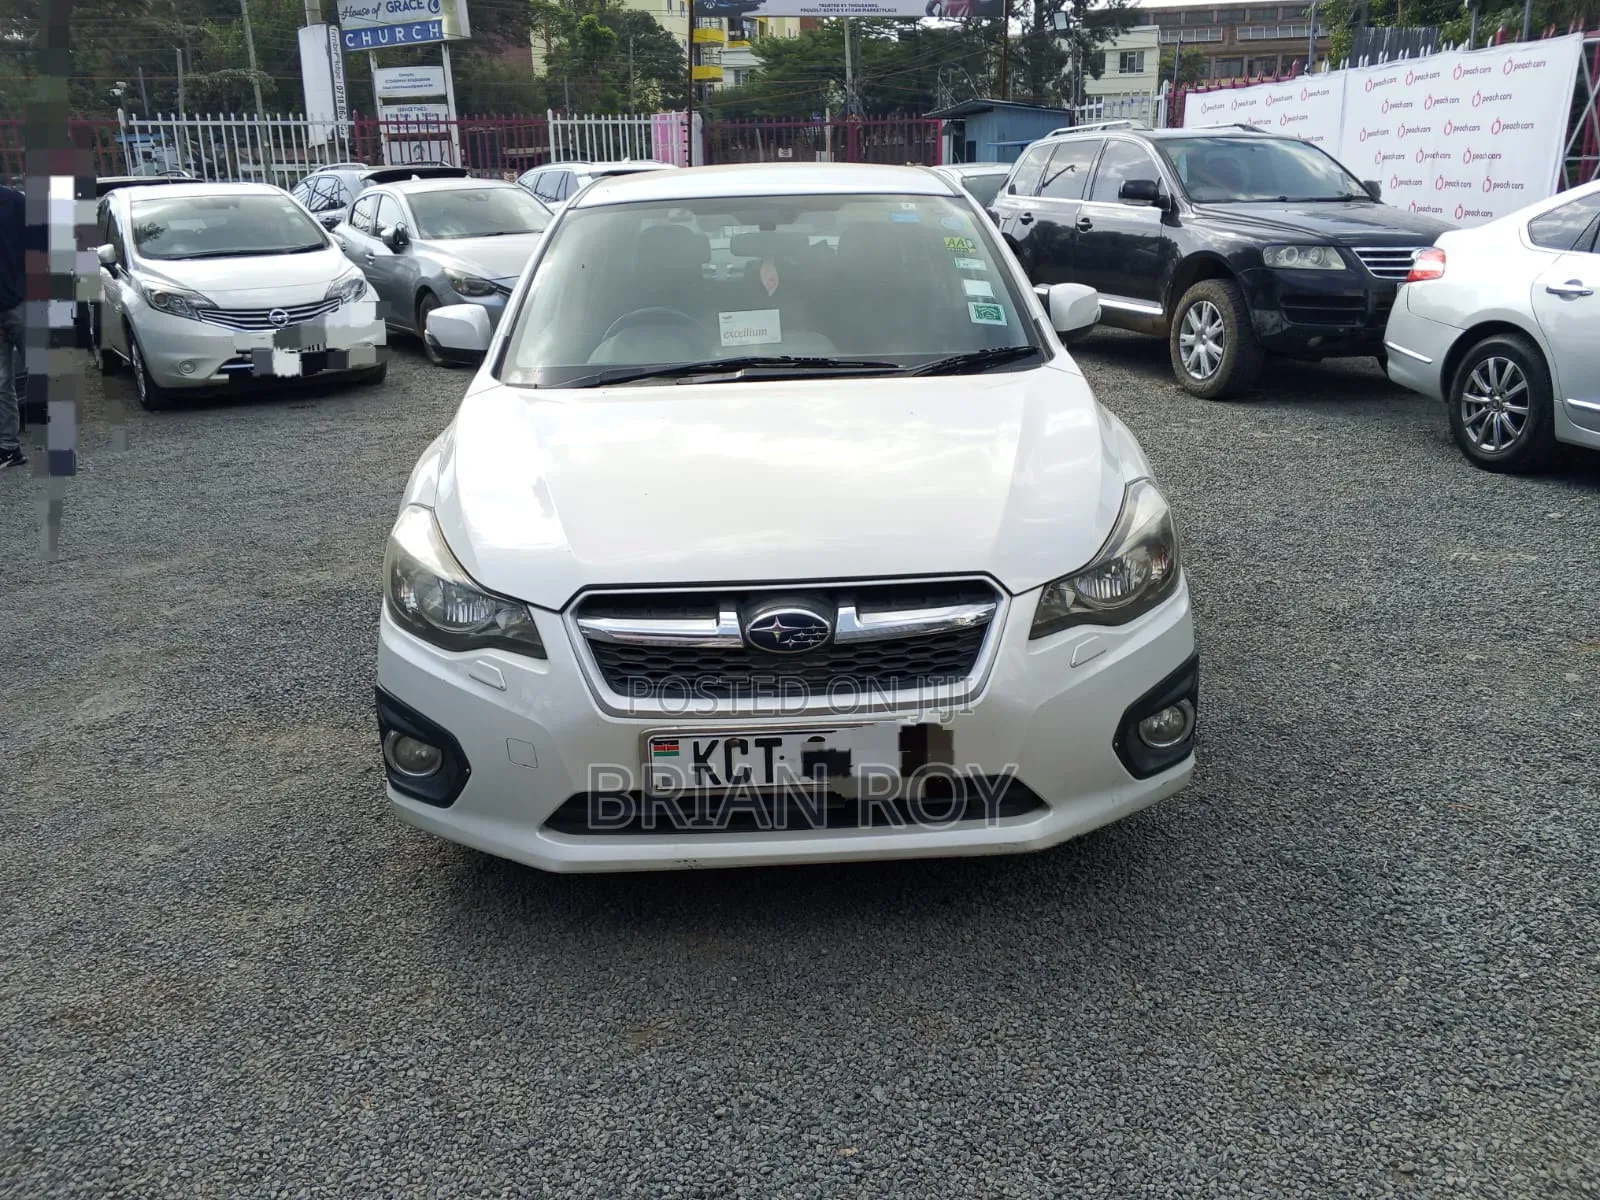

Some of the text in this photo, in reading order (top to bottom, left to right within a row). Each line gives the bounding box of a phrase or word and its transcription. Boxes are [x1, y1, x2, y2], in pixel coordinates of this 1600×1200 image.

[341, 0, 424, 20] House of GRACE
[345, 23, 440, 47] CHURCH
[1463, 66, 1478, 77] peach
[1514, 60, 1532, 72] peach
[1414, 72, 1429, 83] peach
[1373, 78, 1387, 89] peach
[1433, 96, 1448, 107] peach
[1482, 92, 1499, 104] peach
[1390, 101, 1402, 110] peach
[1406, 125, 1420, 135] peach
[1453, 123, 1468, 134] peach
[1502, 121, 1520, 132] peach
[1367, 129, 1379, 139] peach
[1424, 152, 1439, 160] peach
[1472, 152, 1487, 162] peach
[1398, 178, 1412, 188] peach
[1444, 179, 1459, 189] peach
[1493, 180, 1510, 191] peach
[1416, 204, 1431, 214] peach
[1464, 209, 1480, 219] peach
[723, 328, 768, 339] excellium
